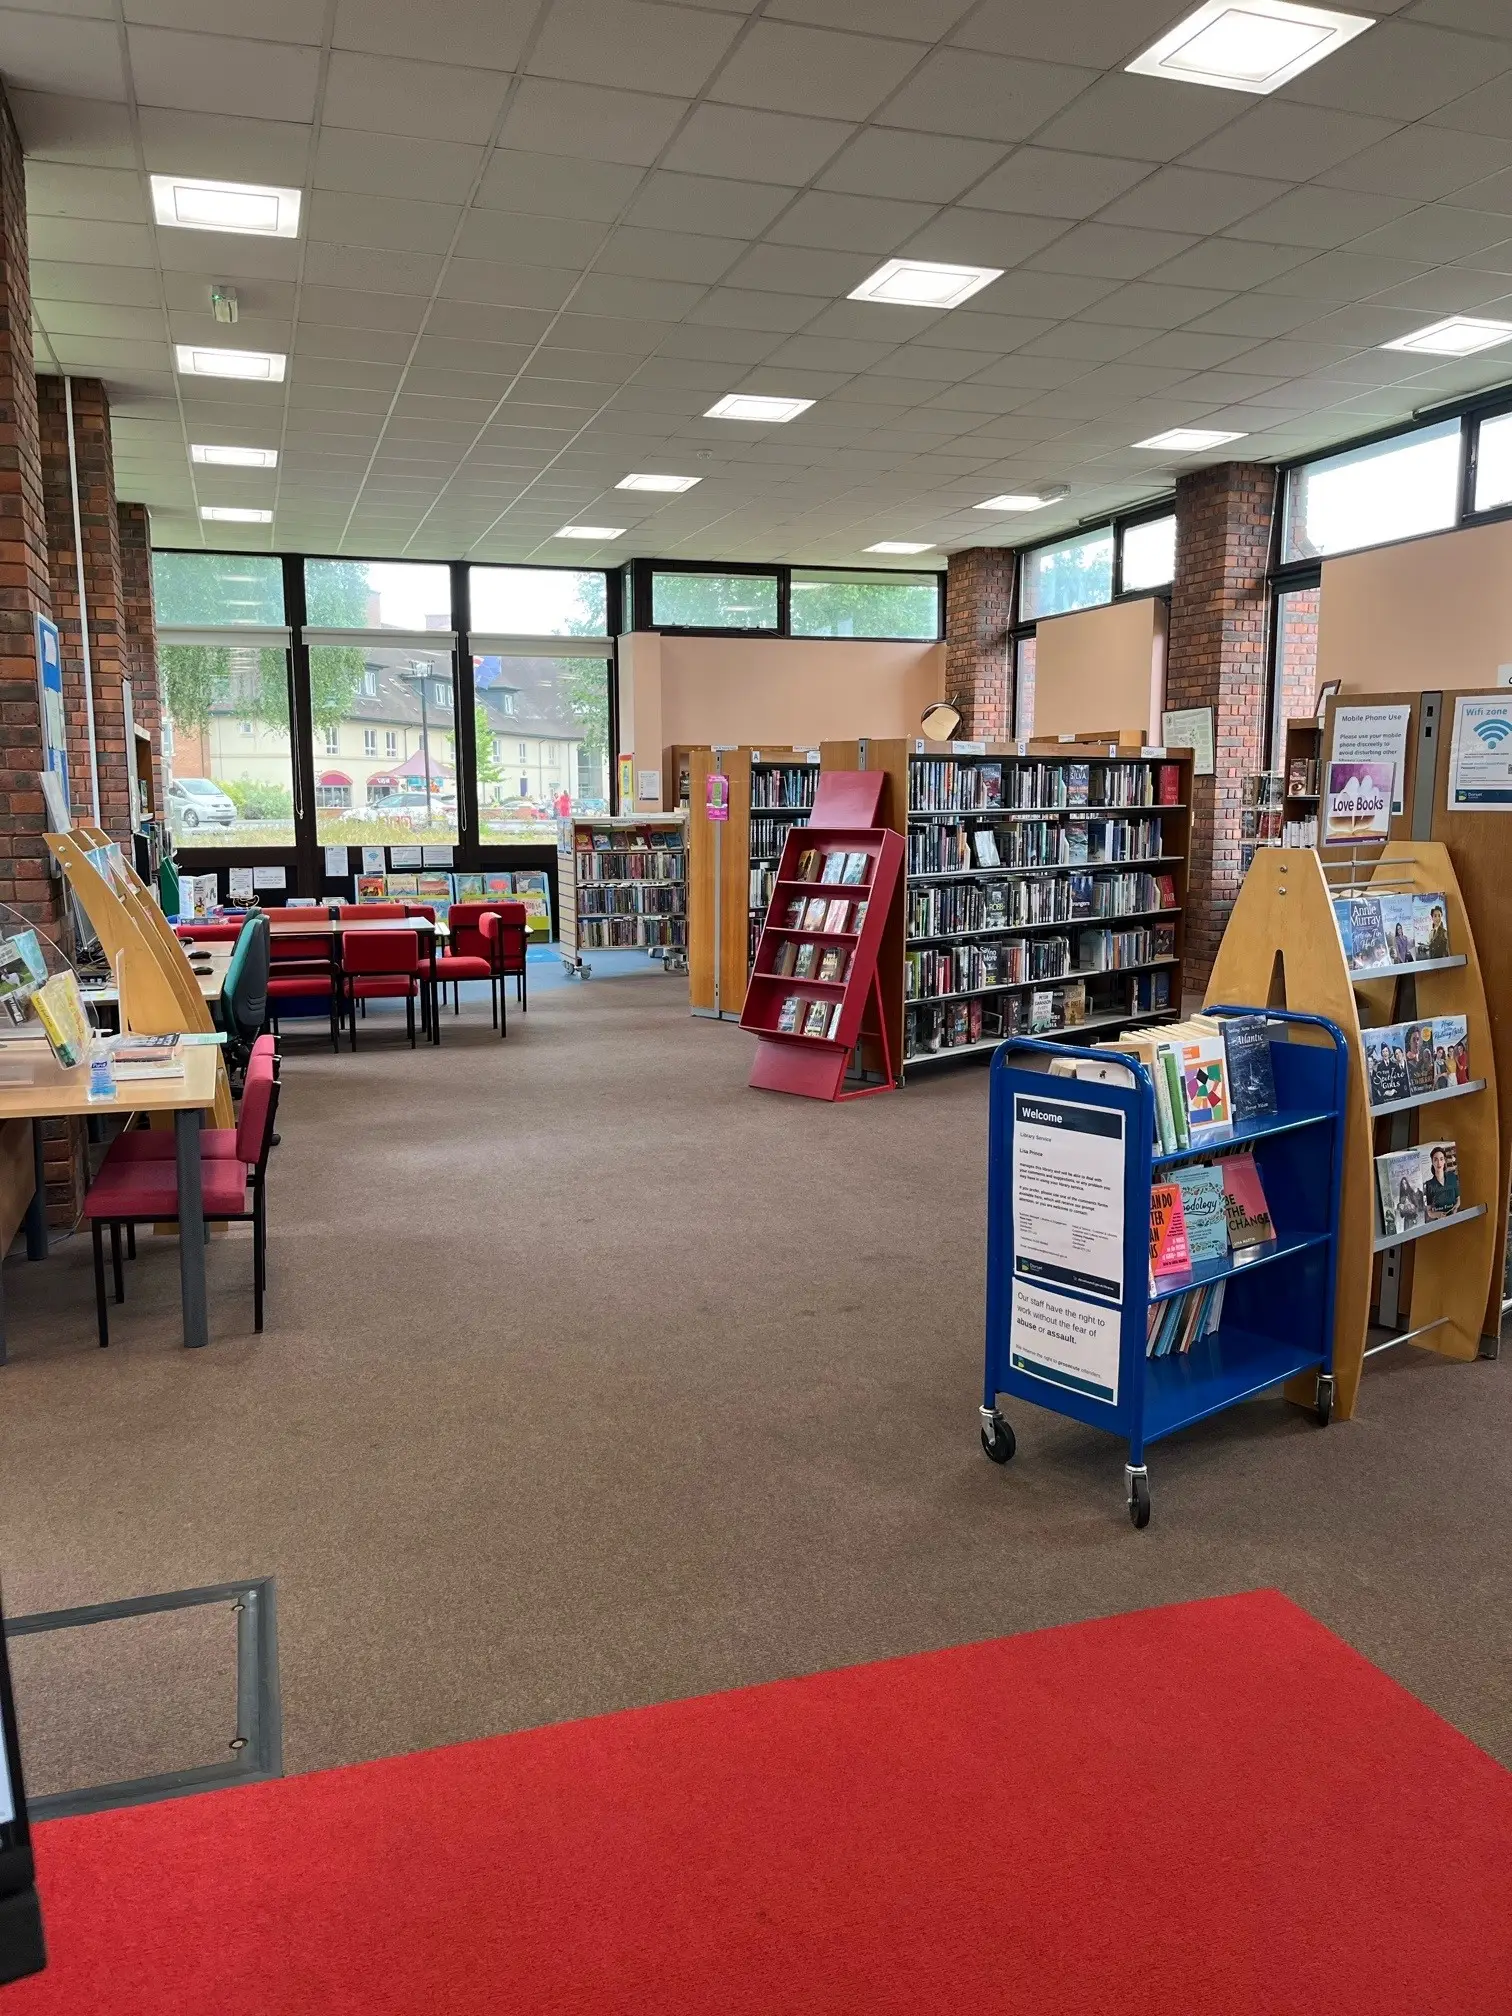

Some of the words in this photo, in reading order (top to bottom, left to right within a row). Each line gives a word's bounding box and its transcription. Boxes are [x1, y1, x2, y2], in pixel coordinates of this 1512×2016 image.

[1466, 708, 1484, 716] Wifi
[1486, 708, 1508, 716] zone
[1020, 744, 1024, 754] S
[754, 752, 758, 760] A
[1333, 798, 1354, 812] Love
[1356, 796, 1384, 810] Books
[1352, 905, 1376, 918] Annie
[1350, 915, 1381, 927] Murray
[1235, 1033, 1264, 1044] Atlantic
[1022, 1107, 1062, 1123] Welcome
[1020, 1132, 1034, 1140] Library
[1226, 1205, 1246, 1218] THE
[1228, 1212, 1270, 1231] CHANGE
[1018, 1292, 1030, 1302] Our
[1030, 1297, 1044, 1308] staff
[1046, 1302, 1062, 1314] have
[1065, 1308, 1076, 1318] the
[1078, 1313, 1095, 1324] right
[1097, 1318, 1106, 1327] to
[1016, 1305, 1032, 1316] work
[1033, 1312, 1057, 1326] without
[1058, 1320, 1070, 1329] the
[1072, 1324, 1086, 1336] fear
[1088, 1329, 1097, 1338] of
[1016, 1317, 1036, 1331] abuse
[1038, 1326, 1046, 1334] or
[1046, 1328, 1076, 1344] assault.
[1058, 1360, 1080, 1372] prosecute
